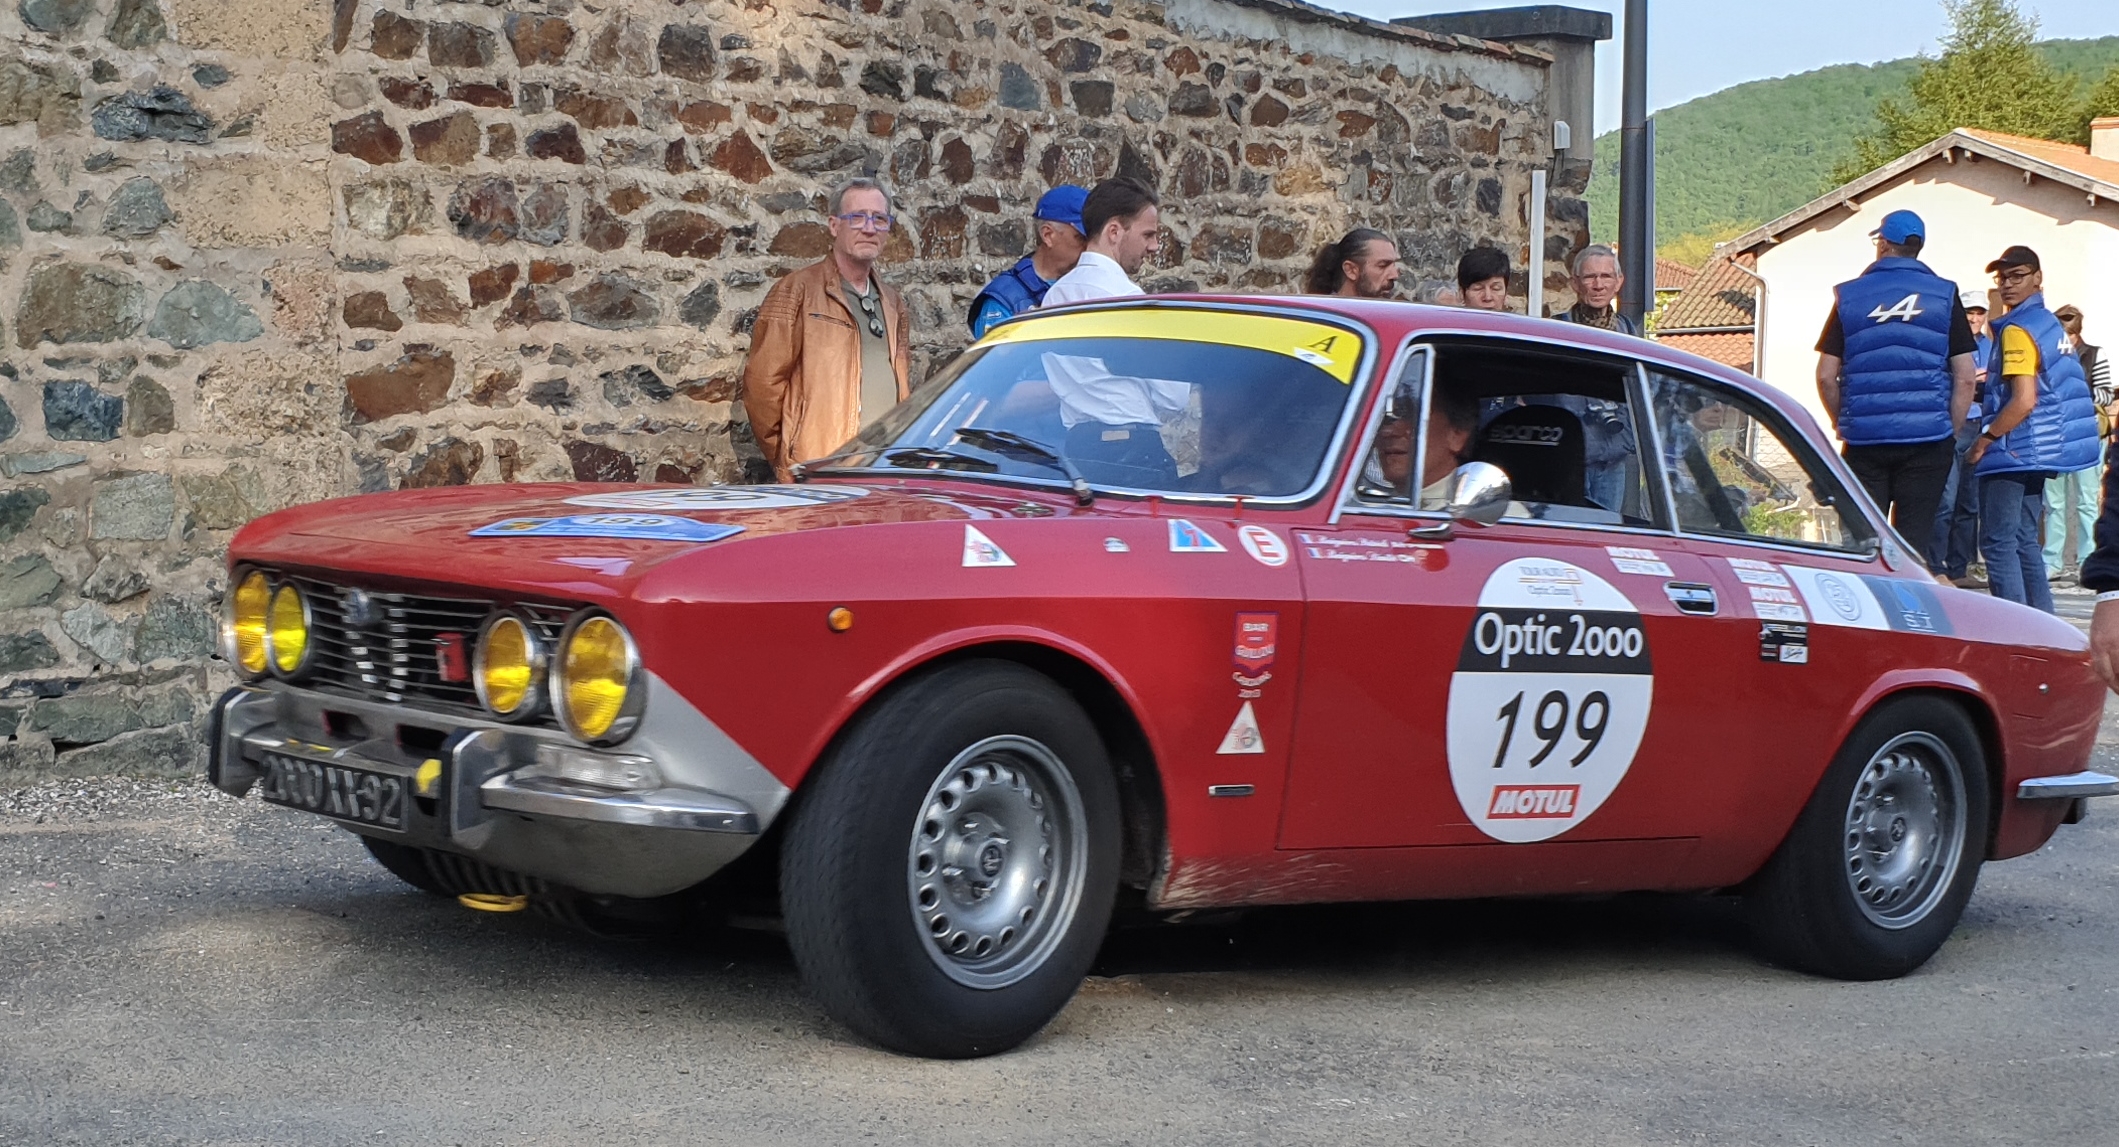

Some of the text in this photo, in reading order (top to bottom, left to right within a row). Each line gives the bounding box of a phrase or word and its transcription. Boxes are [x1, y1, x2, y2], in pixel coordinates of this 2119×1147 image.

[1307, 335, 1338, 354] A
[588, 516, 664, 525] 199
[1247, 531, 1281, 558] E
[1474, 612, 1643, 668] Optic 2000
[1492, 690, 1610, 769] 199
[1491, 789, 1576, 815] MOTUL
